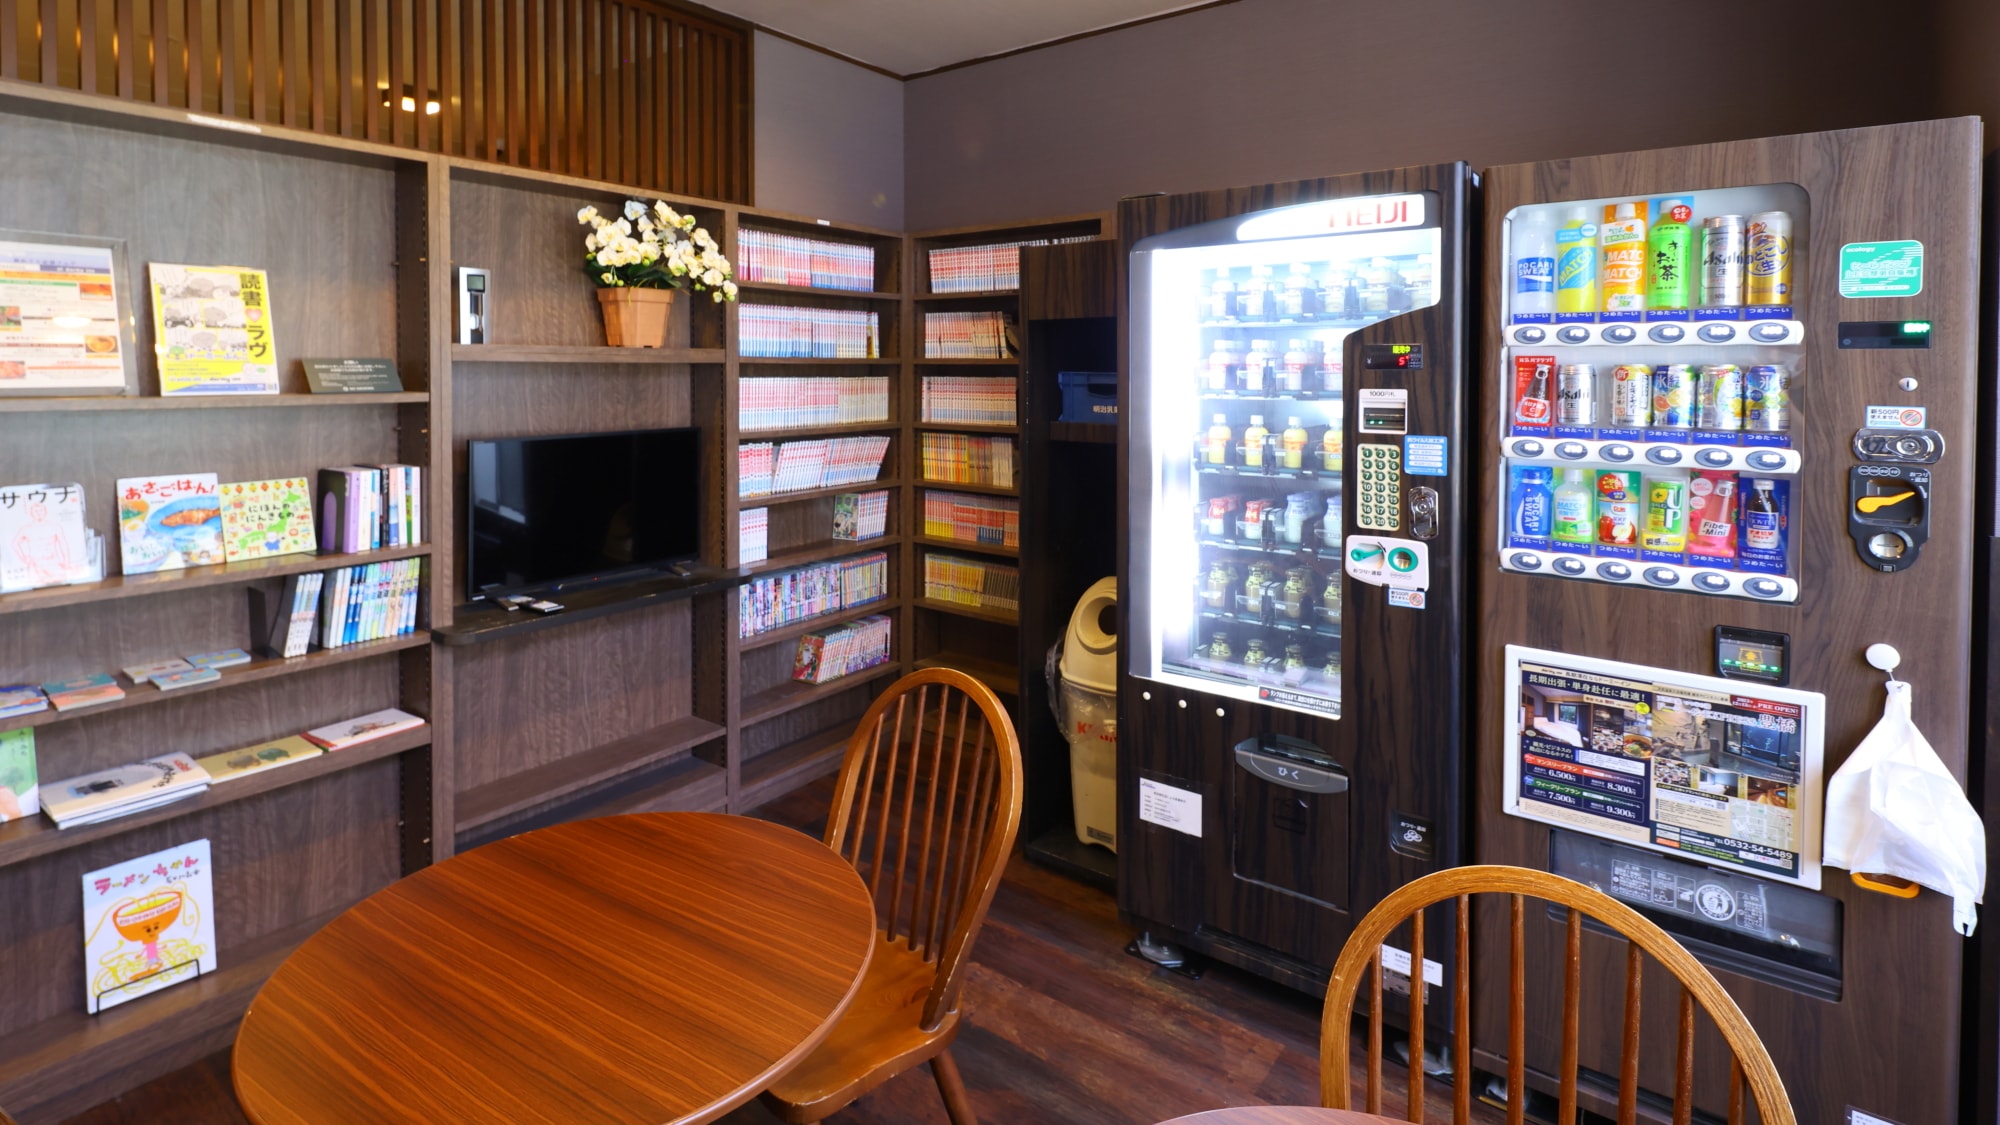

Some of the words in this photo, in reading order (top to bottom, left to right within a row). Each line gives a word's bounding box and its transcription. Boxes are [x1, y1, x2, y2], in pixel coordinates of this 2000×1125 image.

[1518, 261, 1553, 269] POCARI
[1518, 268, 1549, 276] SWEAT
[0, 486, 76, 510] サウナ
[249, 502, 290, 513] にほんの
[246, 512, 295, 523] にんきもの
[1528, 674, 1646, 702] 長期出張・単身赴任に最適!
[1757, 702, 1773, 710] PRE
[1535, 758, 1578, 772] マンスリープラン
[1535, 780, 1581, 795] ウィークリープラン
[1723, 838, 1793, 860] 0532-54-5489
[94, 855, 200, 896] ラーメンちゃん
